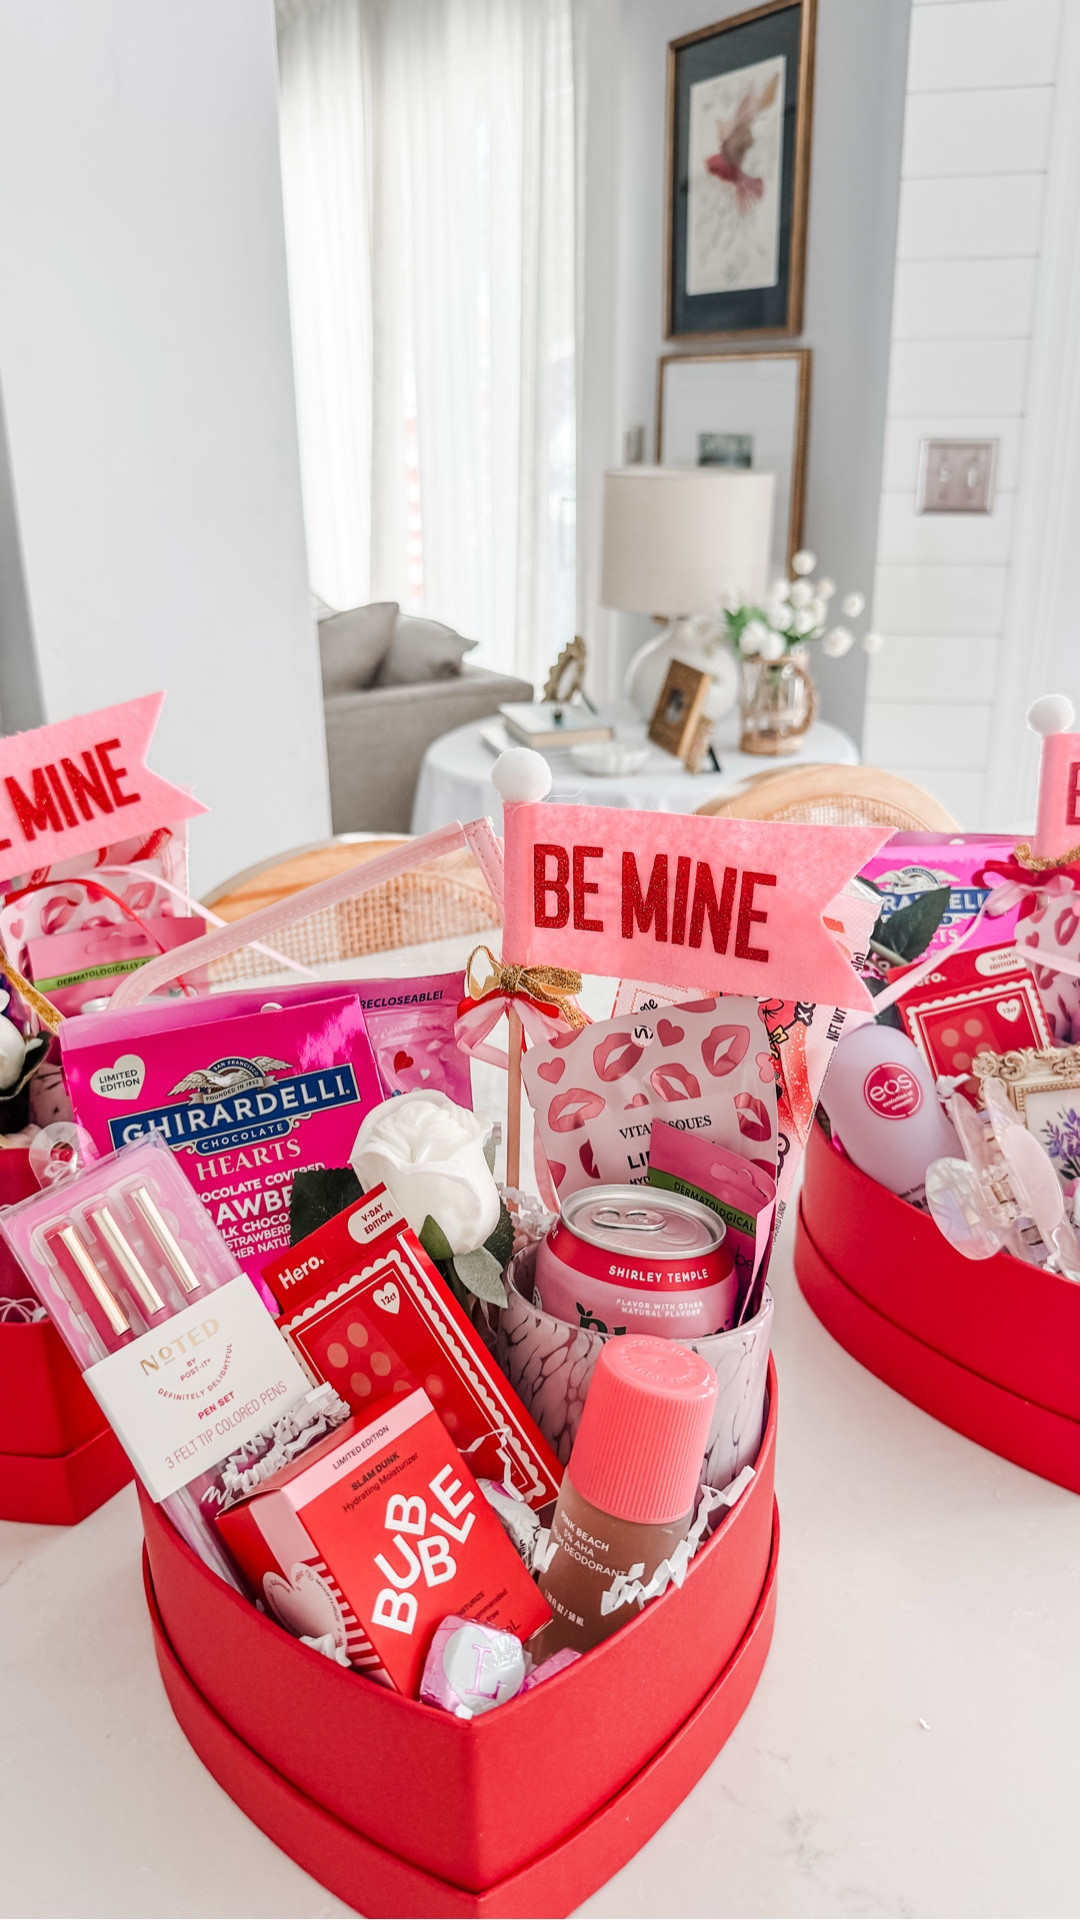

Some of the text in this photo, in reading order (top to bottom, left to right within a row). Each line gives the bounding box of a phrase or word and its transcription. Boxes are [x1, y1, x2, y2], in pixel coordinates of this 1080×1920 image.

[5, 738, 141, 842] MINE
[533, 843, 777, 963] BE MINE
[56, 962, 140, 987] DERMATOLOGICALLY
[913, 972, 947, 987] ero.
[360, 990, 443, 1009] RECLOSEABLE!
[834, 1007, 847, 1023] WT
[99, 1069, 138, 1084] LIMITED
[213, 1059, 259, 1076] SAN FRANCISCO
[100, 1078, 140, 1093] EDITION
[205, 1087, 236, 1101] FOUNDED
[870, 1074, 912, 1102] eos
[201, 1123, 284, 1150] CHOCOLATE
[619, 1115, 712, 1139] VITASQUES
[195, 1138, 301, 1180] HEARTS
[199, 1178, 262, 1203] OCOLATE
[242, 1211, 291, 1233] CHOCO
[361, 1202, 384, 1222] V-DAY
[364, 1210, 394, 1235] EDITION
[226, 1224, 291, 1248] STRAWBERR
[278, 1256, 324, 1290] Hero.
[609, 1265, 709, 1284] SHIRLEY TEMPLE
[380, 1292, 397, 1306] 12ct
[616, 1298, 704, 1310] FLAVOR WITH OTHER
[621, 1307, 700, 1317] NATURAL FLAVORS
[158, 1343, 233, 1401] DEFINITELY DELIGHTFUL
[186, 1357, 197, 1368] BY
[197, 1391, 236, 1420] PEN SET
[165, 1380, 288, 1469] 3 FELT TIP COLORED PENS
[333, 1425, 390, 1470] LIMITED EDITION
[342, 1452, 419, 1513] Hydrating Moisturizer
[351, 1451, 401, 1491] SLAM DUNK
[561, 1510, 610, 1552] PINK BEACH
[563, 1529, 595, 1558] 5% AHA
[564, 1543, 629, 1577] DEODORANT
[465, 1643, 502, 1699] L
